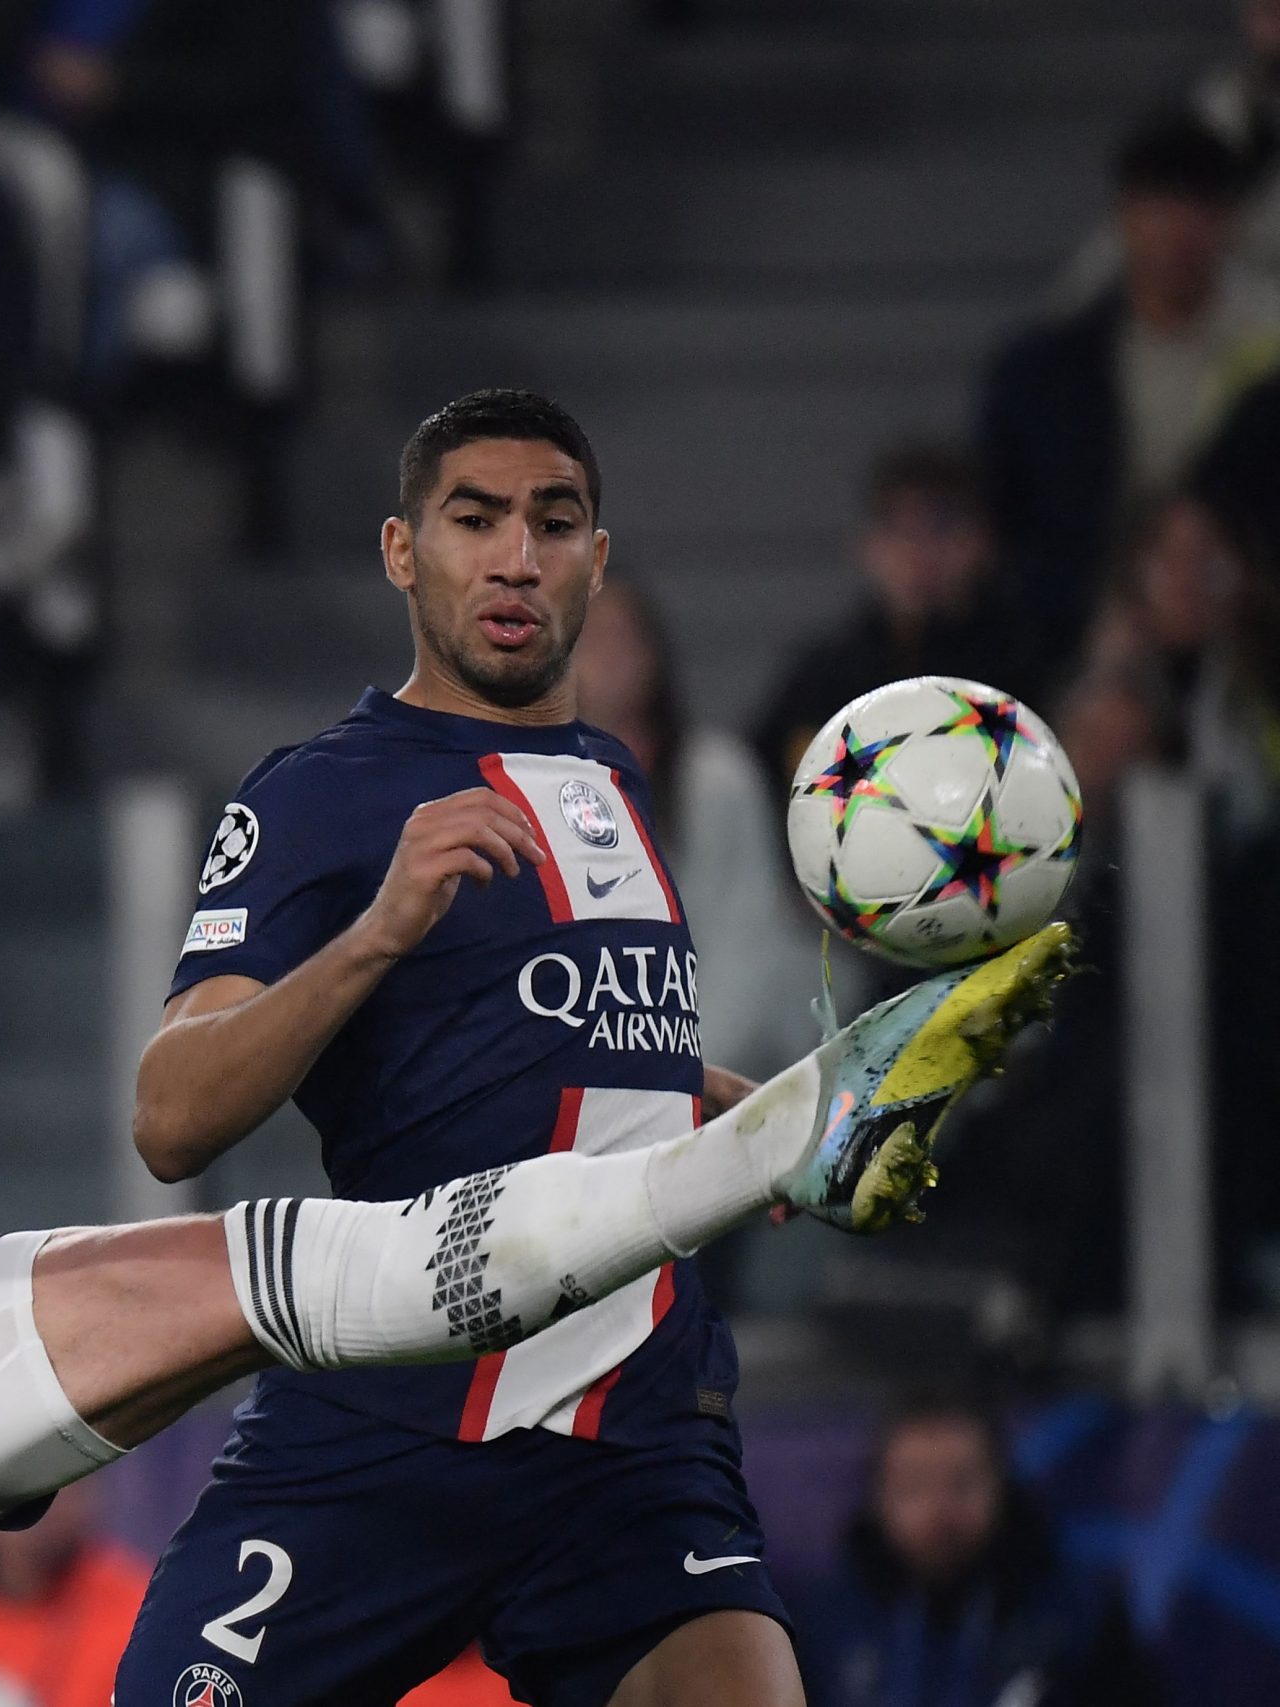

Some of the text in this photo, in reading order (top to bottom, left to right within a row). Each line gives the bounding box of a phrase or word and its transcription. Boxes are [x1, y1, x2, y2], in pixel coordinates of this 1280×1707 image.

[189, 921, 242, 937] ATION
[518, 946, 700, 1027] QATAR
[201, 1539, 293, 1664] 2
[192, 1667, 235, 1696] PARIS
